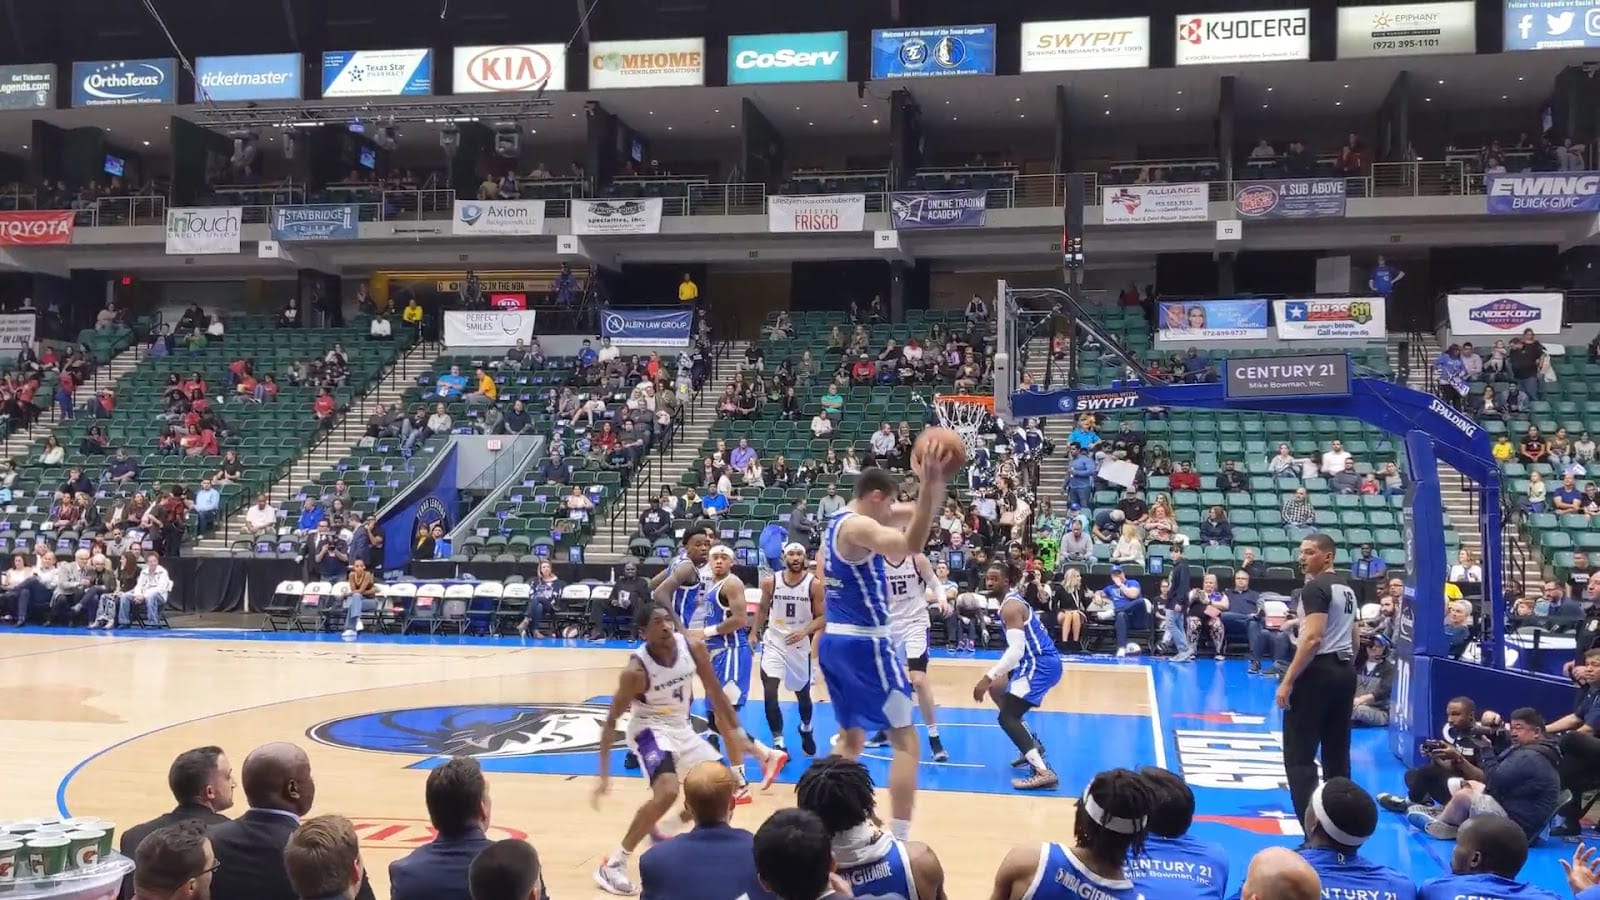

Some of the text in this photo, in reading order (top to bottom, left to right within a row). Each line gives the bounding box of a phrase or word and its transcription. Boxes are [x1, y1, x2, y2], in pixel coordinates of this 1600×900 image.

[1395, 13, 1438, 22] EPIPHANY
[1206, 17, 1307, 40] KYOCERA
[1037, 30, 1133, 49] SWYPIT
[1373, 38, 1439, 50] (972) 395-1101
[735, 49, 839, 70] CoServ
[482, 57, 537, 81] KIA
[91, 72, 159, 88] OrthoTexas
[202, 71, 288, 87] ticketmaster
[1147, 187, 1200, 195] ALLIANCE
[1280, 182, 1344, 195] A SUB ABOVE
[1491, 176, 1600, 197] EWING
[928, 196, 985, 210] ONLINE TRADING
[285, 209, 344, 220] STAYBRIDGE
[487, 205, 528, 217] Axiom
[928, 210, 963, 220] ACADEMY
[795, 214, 838, 231] FRISCO
[498, 282, 510, 290] THE
[466, 313, 498, 322] PERFECT
[1471, 309, 1540, 318] KNOCKOUT
[466, 322, 493, 331] SMILES
[645, 321, 659, 329] LAW
[1235, 364, 1336, 380] CENTURY 21
[1270, 380, 1308, 389] Bowman,
[1076, 395, 1139, 411] SWYPIT
[1428, 399, 1478, 438] SPALDING
[886, 573, 916, 581] TOCKTON
[891, 580, 907, 596] 12
[786, 602, 796, 618] 8
[672, 685, 684, 702] 4
[1124, 872, 1146, 880] Mike
[1150, 870, 1194, 881] Bowman,
[1199, 865, 1212, 878] 21
